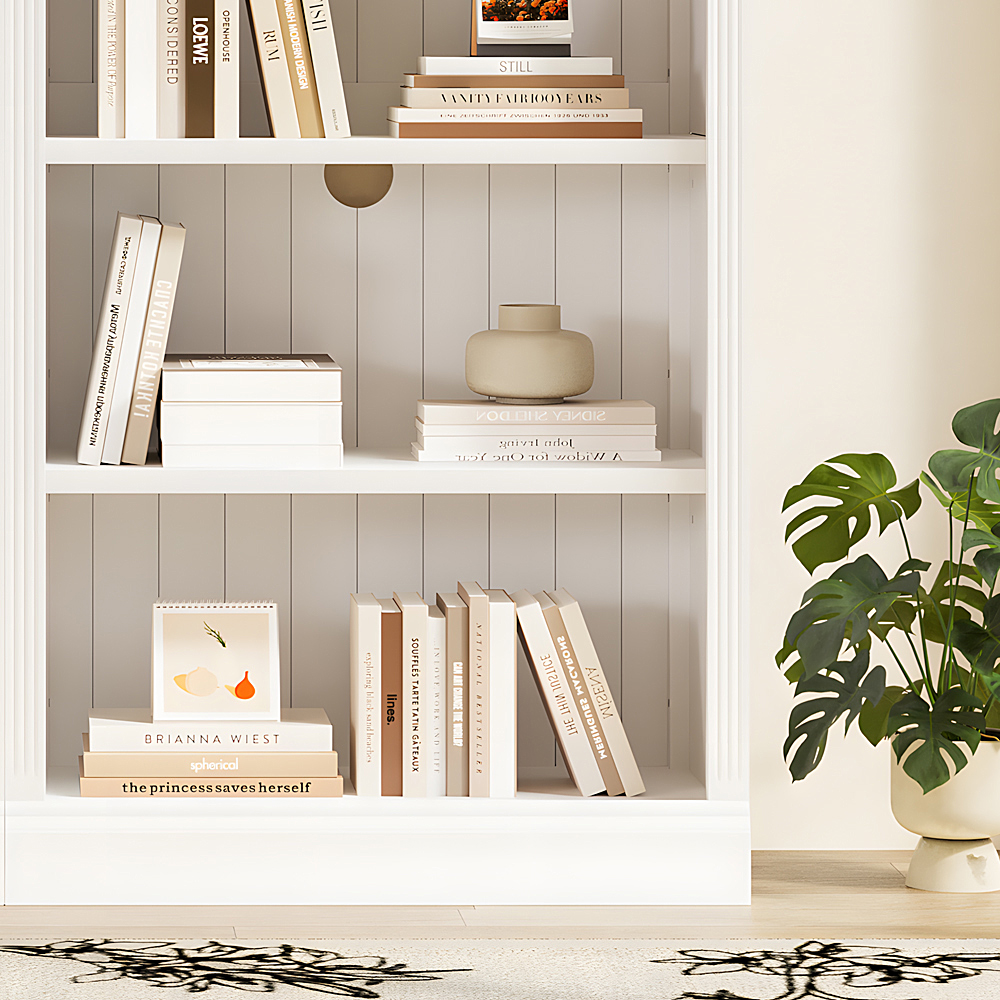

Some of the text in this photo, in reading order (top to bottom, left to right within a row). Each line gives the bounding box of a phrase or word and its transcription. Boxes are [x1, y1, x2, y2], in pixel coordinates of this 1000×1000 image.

[192, 17, 208, 64] LOEWE
[222, 10, 230, 63] OPENHOUSE
[262, 30, 280, 61] RUM
[288, 24, 305, 59] MODERN
[294, 60, 309, 90] DESIGN
[499, 61, 533, 73] STILL
[441, 94, 490, 104] VANITY
[411, 638, 421, 677] SOUFFLÉS
[364, 652, 374, 763] exploring black sand beaches
[411, 680, 419, 705] TARTE
[453, 662, 463, 747] CAN ART CHANGE THE WORLD?
[386, 694, 397, 726] lines.
[145, 734, 280, 744] BRIANNA WIEST
[190, 757, 239, 773] spherical
[122, 782, 312, 796] the princess saves herself
